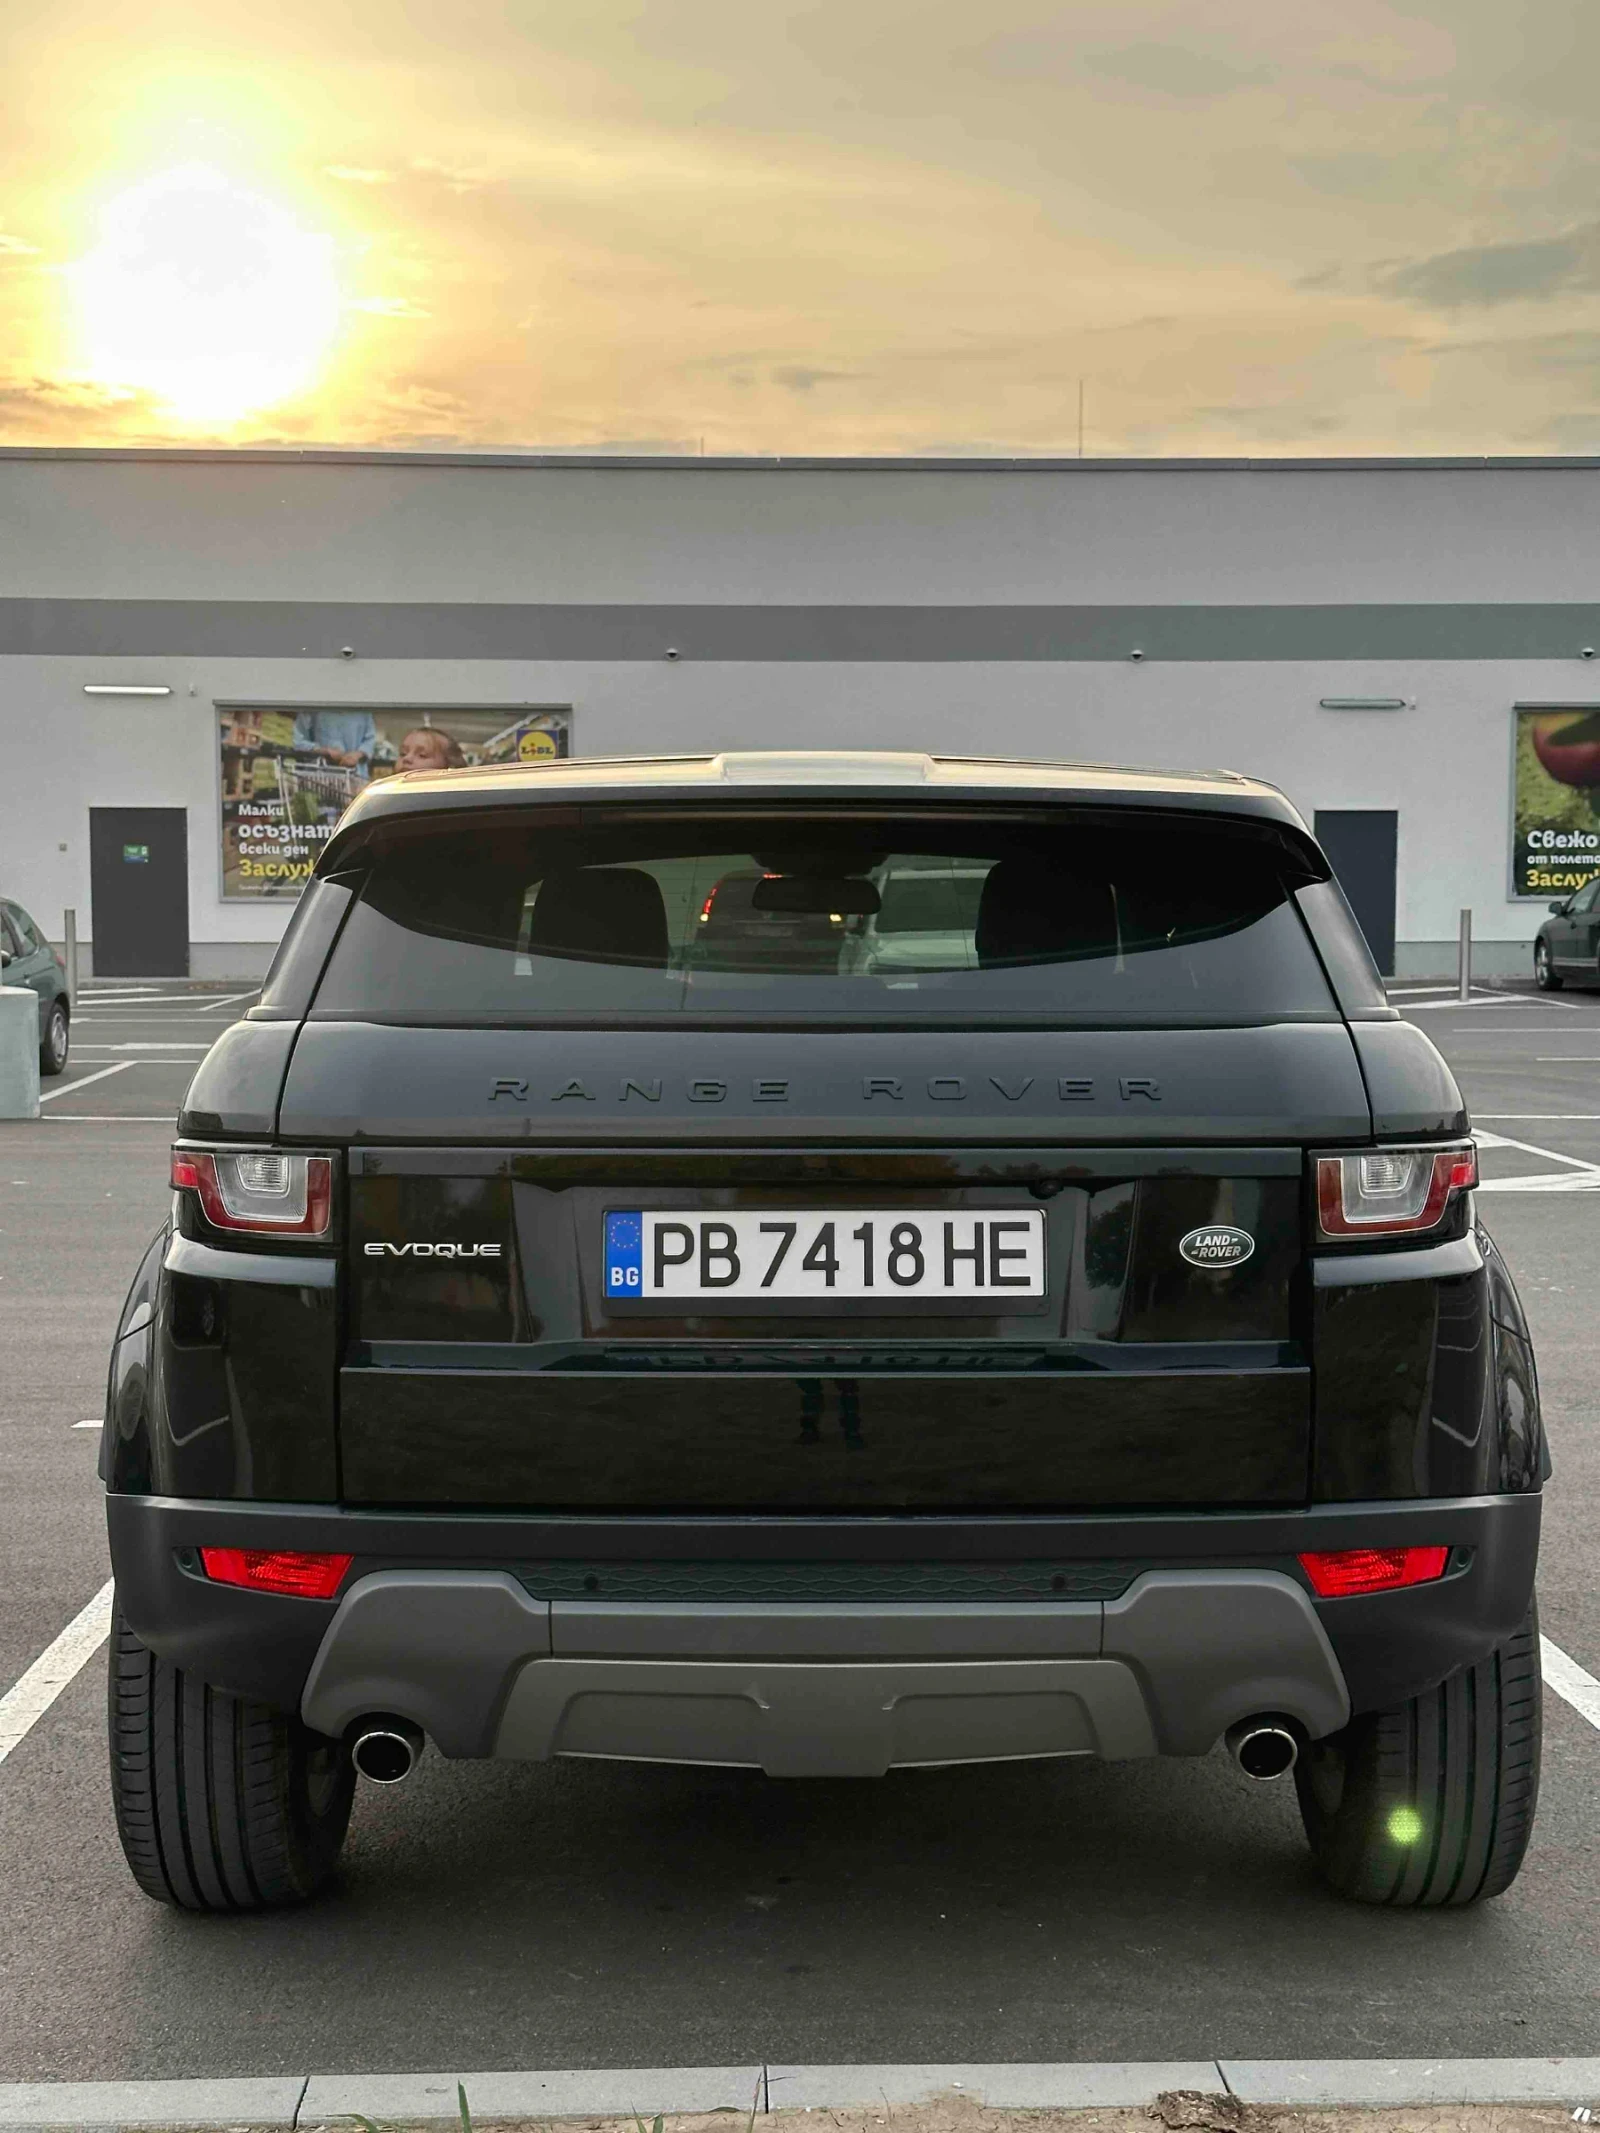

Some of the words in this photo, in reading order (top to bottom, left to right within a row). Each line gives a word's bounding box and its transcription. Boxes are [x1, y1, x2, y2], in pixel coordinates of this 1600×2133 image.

[238, 804, 284, 816] Малки
[1527, 830, 1598, 848] Свежо
[239, 842, 280, 855] всеки
[283, 844, 309, 858] ден
[1527, 855, 1548, 865] от
[488, 1077, 789, 1102] RANGE
[861, 1076, 1163, 1101] ROVER
[1195, 1235, 1230, 1247] LAND
[364, 1242, 501, 1258] EVOQUE
[653, 1222, 741, 1288] PB
[759, 1221, 925, 1288] 7418
[943, 1221, 1032, 1287] HE
[1199, 1246, 1242, 1258] ROVER
[611, 1267, 639, 1287] BG
